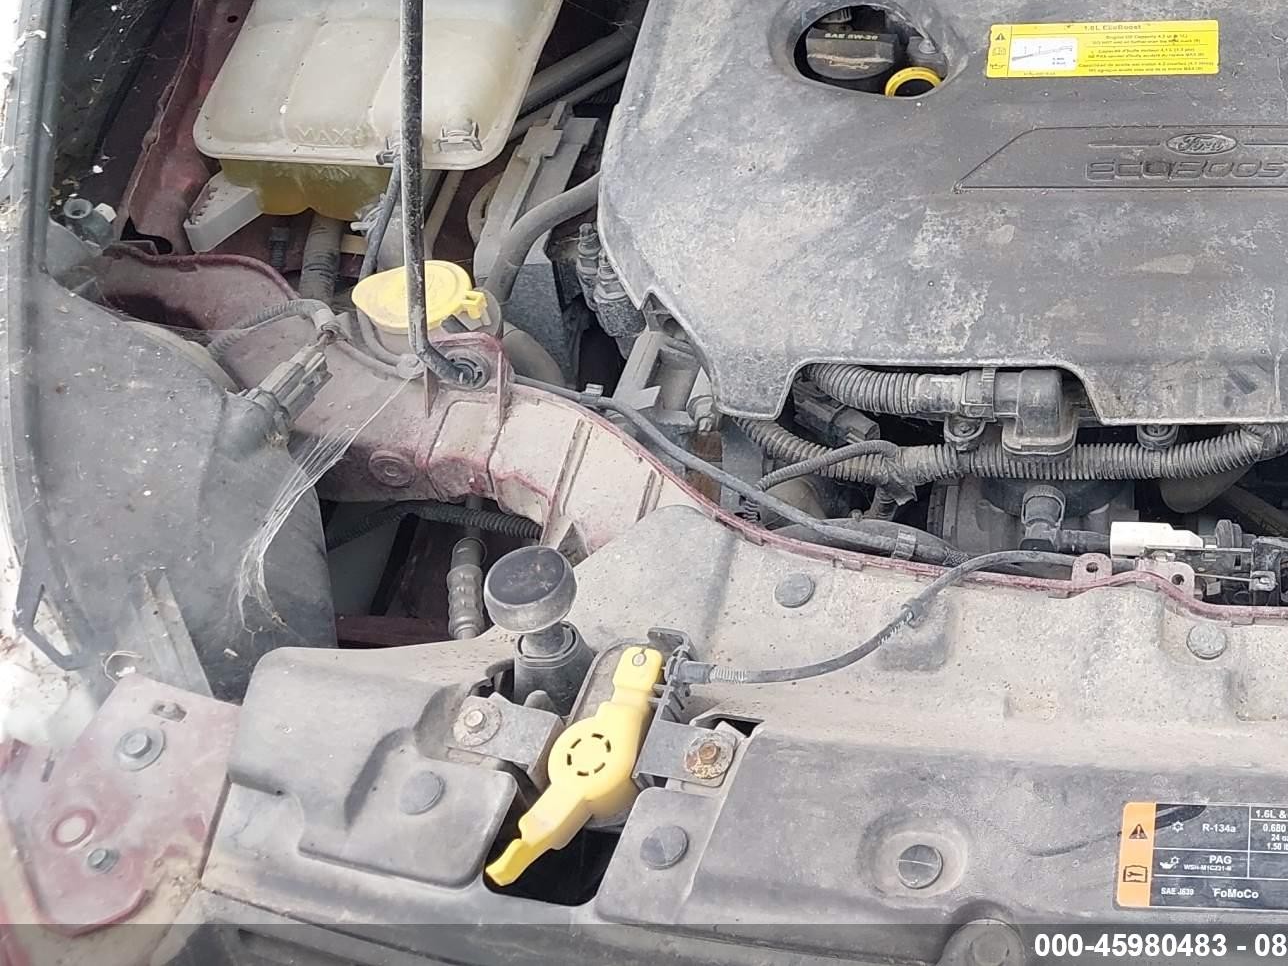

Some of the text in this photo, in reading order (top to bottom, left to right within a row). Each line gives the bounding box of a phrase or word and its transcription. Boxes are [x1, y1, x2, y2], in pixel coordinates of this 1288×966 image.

[1177, 135, 1226, 152] Ford
[1256, 810, 1276, 818] 1.6L
[1279, 810, 1286, 818] &
[1202, 823, 1236, 832] R-134a
[1263, 824, 1286, 832] 0.680
[1209, 856, 1232, 864] PAG
[1178, 888, 1194, 896] J639
[1213, 888, 1259, 899] FoMoCo
